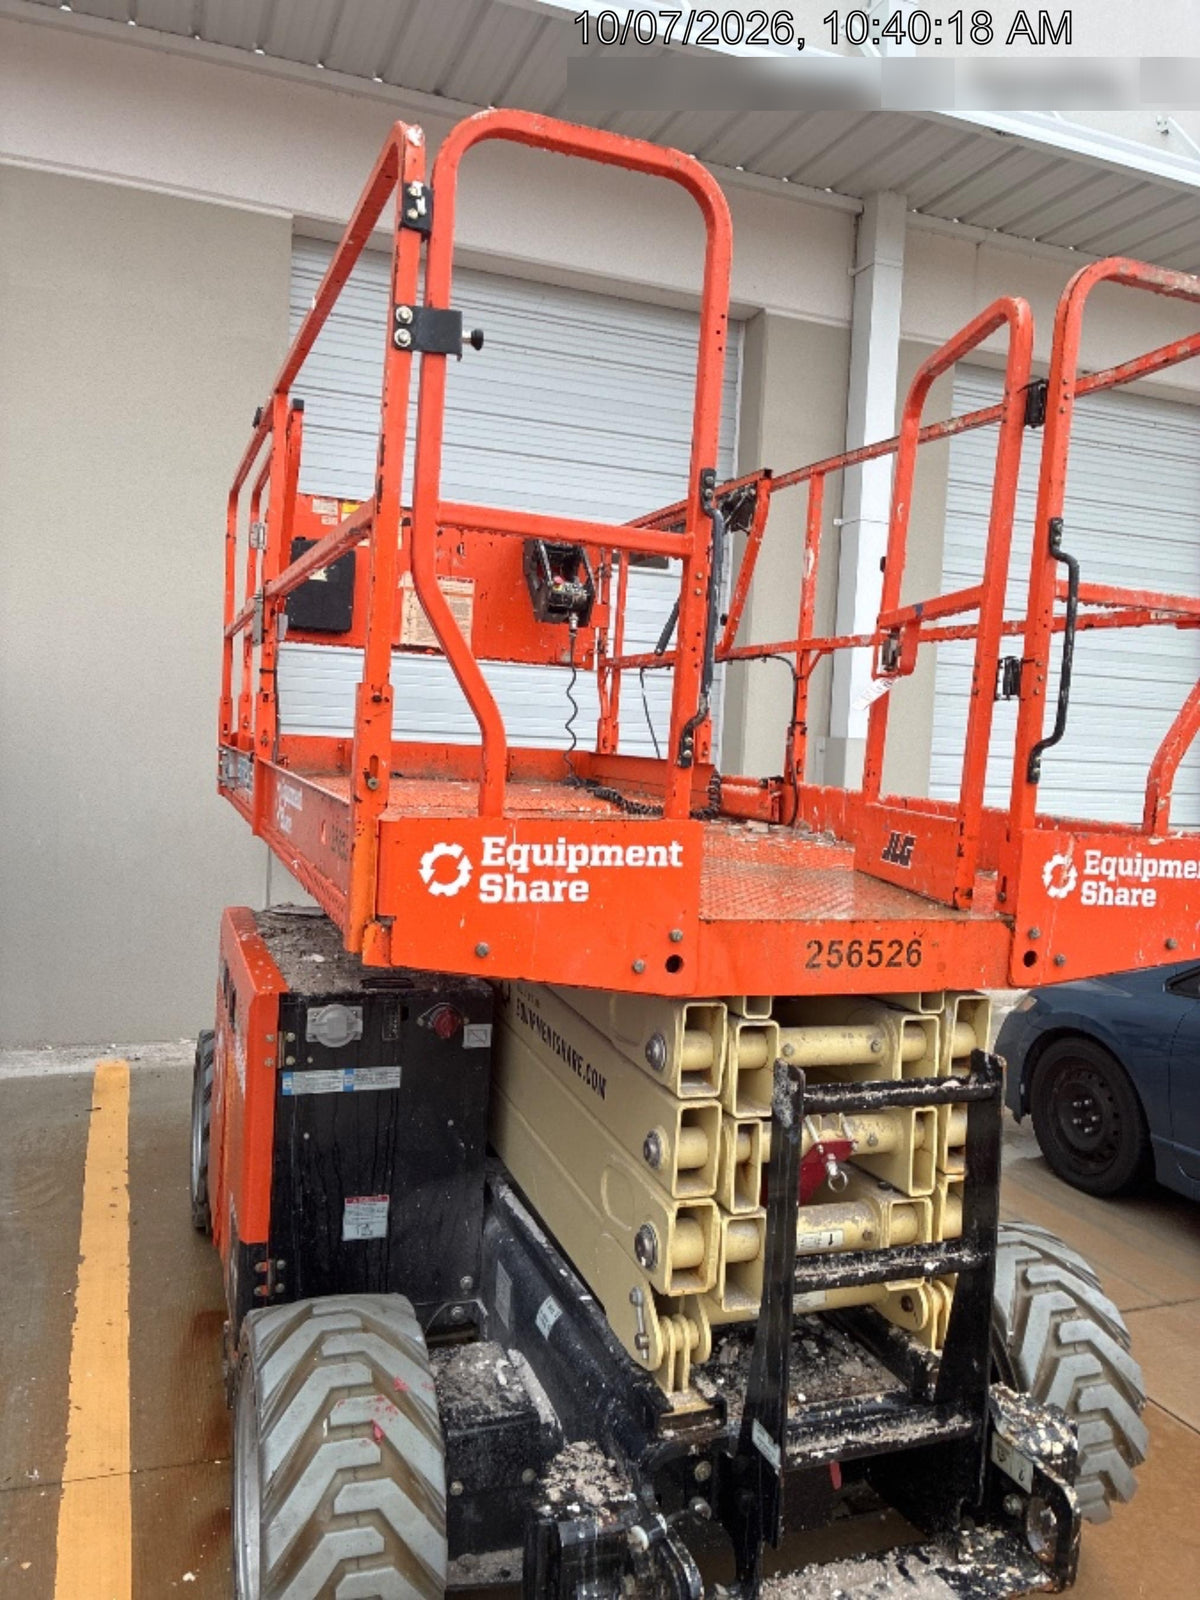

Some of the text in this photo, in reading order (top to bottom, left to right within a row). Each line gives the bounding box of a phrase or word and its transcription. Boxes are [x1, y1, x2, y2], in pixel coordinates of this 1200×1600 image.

[480, 836, 684, 873] Equipment
[1083, 849, 1200, 883] Equipme
[478, 872, 591, 904] Share
[1080, 880, 1157, 908] Share
[805, 939, 923, 970] 256526
